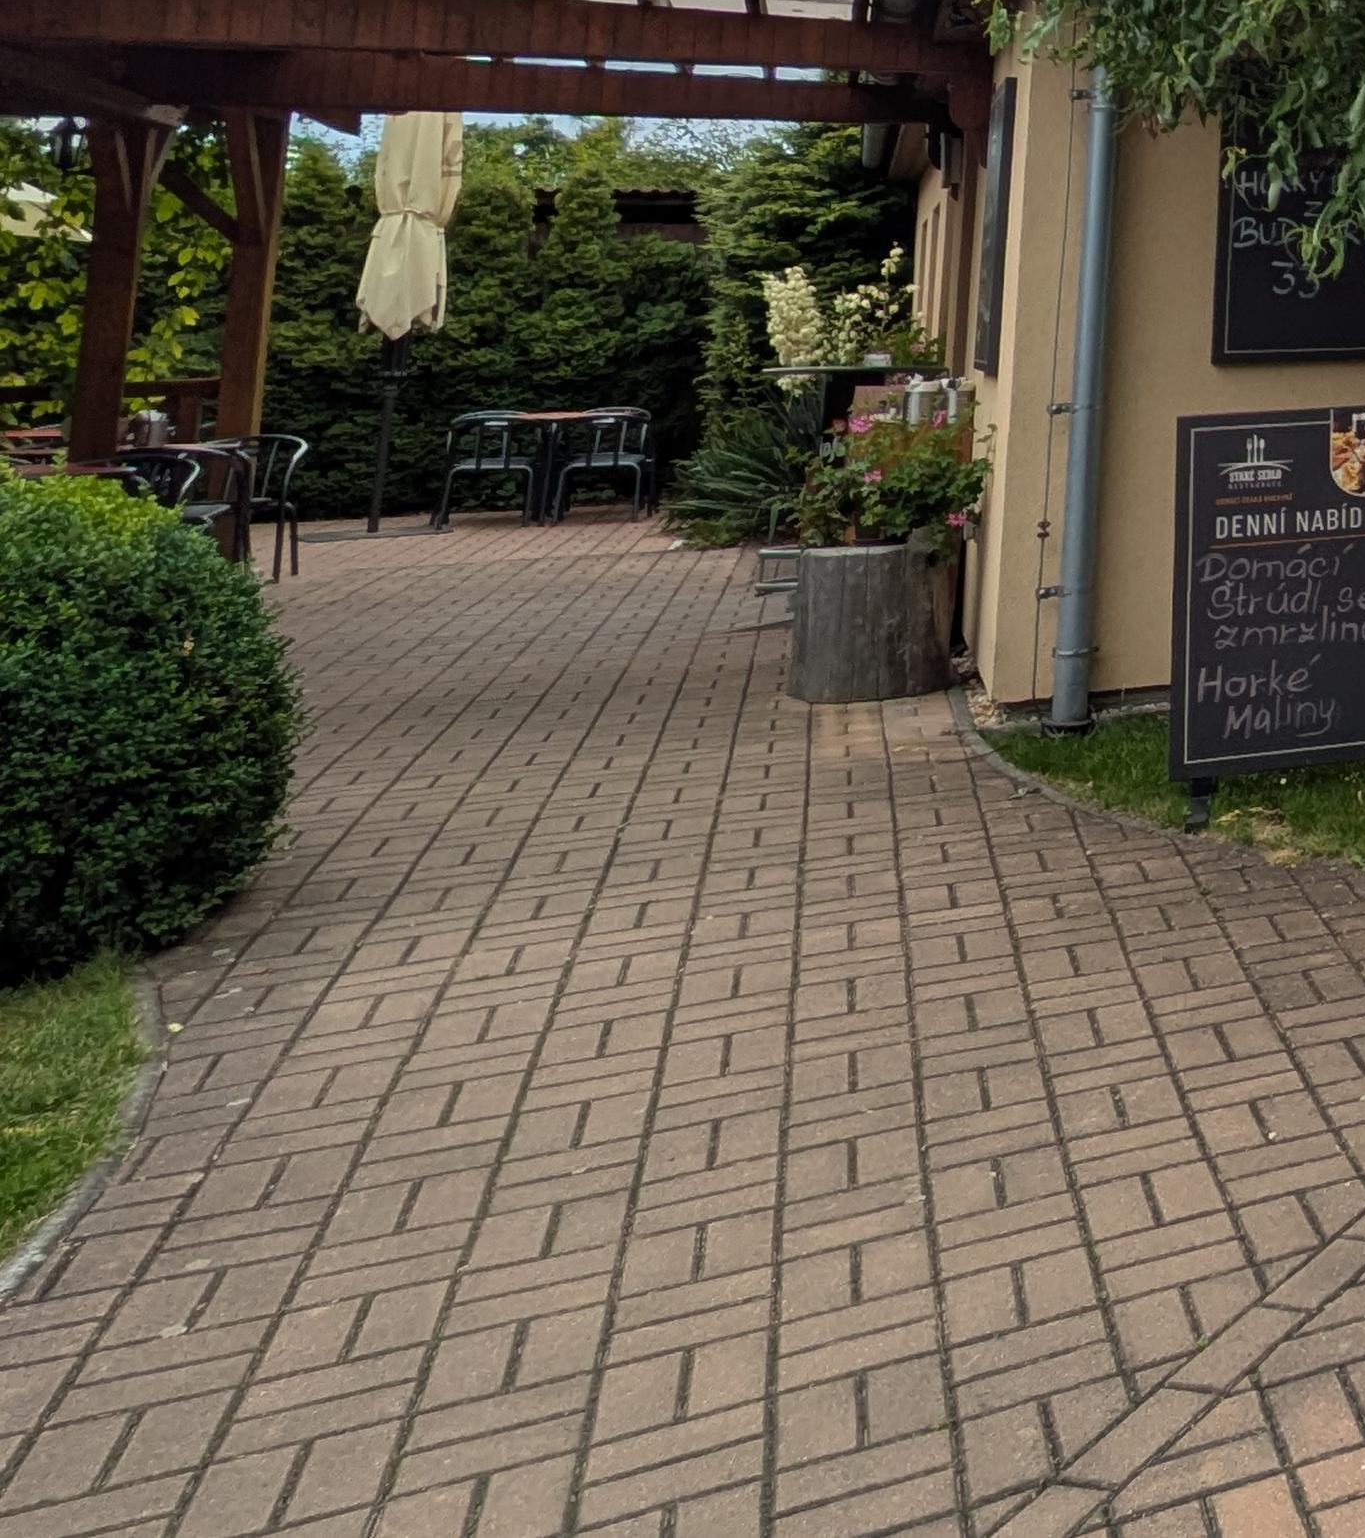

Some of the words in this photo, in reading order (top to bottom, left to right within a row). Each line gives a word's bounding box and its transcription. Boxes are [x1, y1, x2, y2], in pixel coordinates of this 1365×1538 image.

[1215, 507, 1286, 540] DENNÍ
[1196, 543, 1355, 582] Domácí
[1197, 654, 1322, 702] Horké
